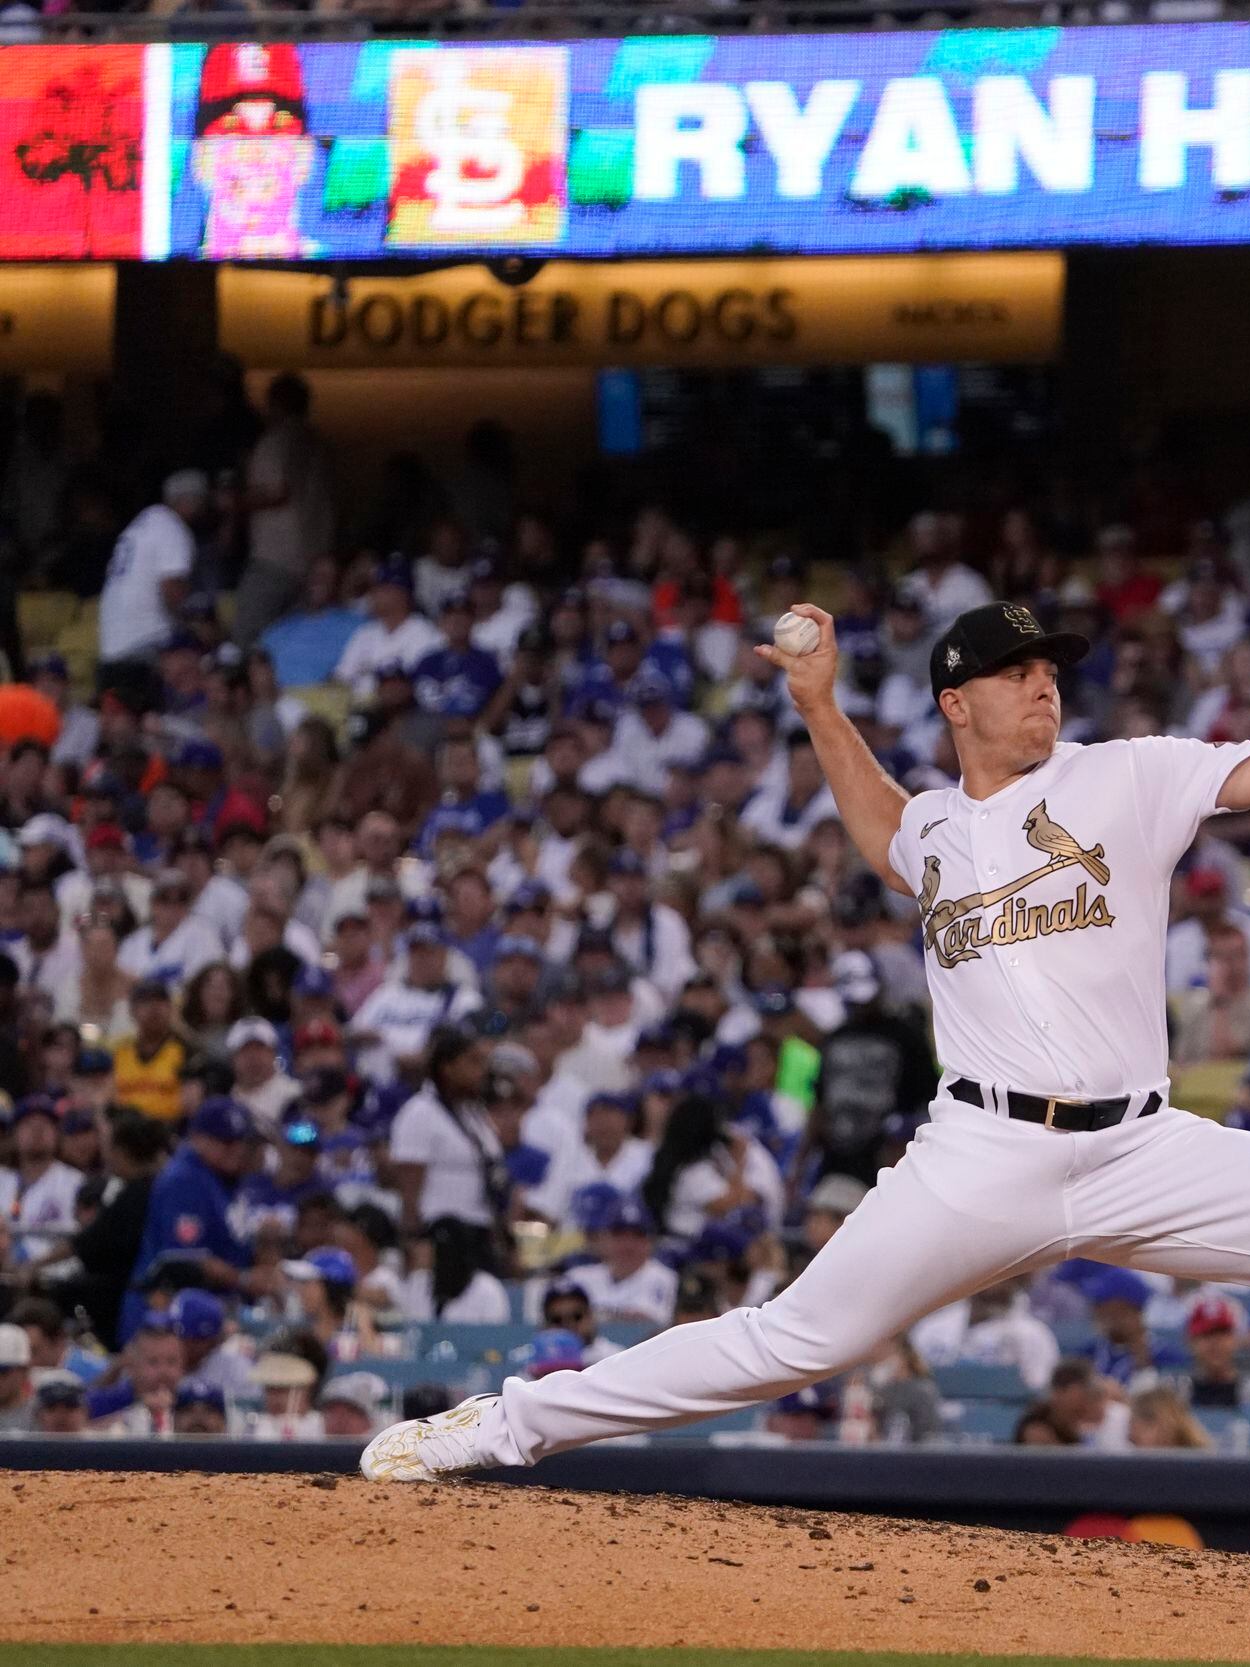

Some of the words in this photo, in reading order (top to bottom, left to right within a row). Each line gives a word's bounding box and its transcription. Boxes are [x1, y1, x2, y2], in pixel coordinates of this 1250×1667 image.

[632, 74, 1097, 201] RYAN
[311, 293, 579, 346] DODGER
[607, 289, 796, 342] DOGS
[924, 881, 1116, 970] Cardinals
